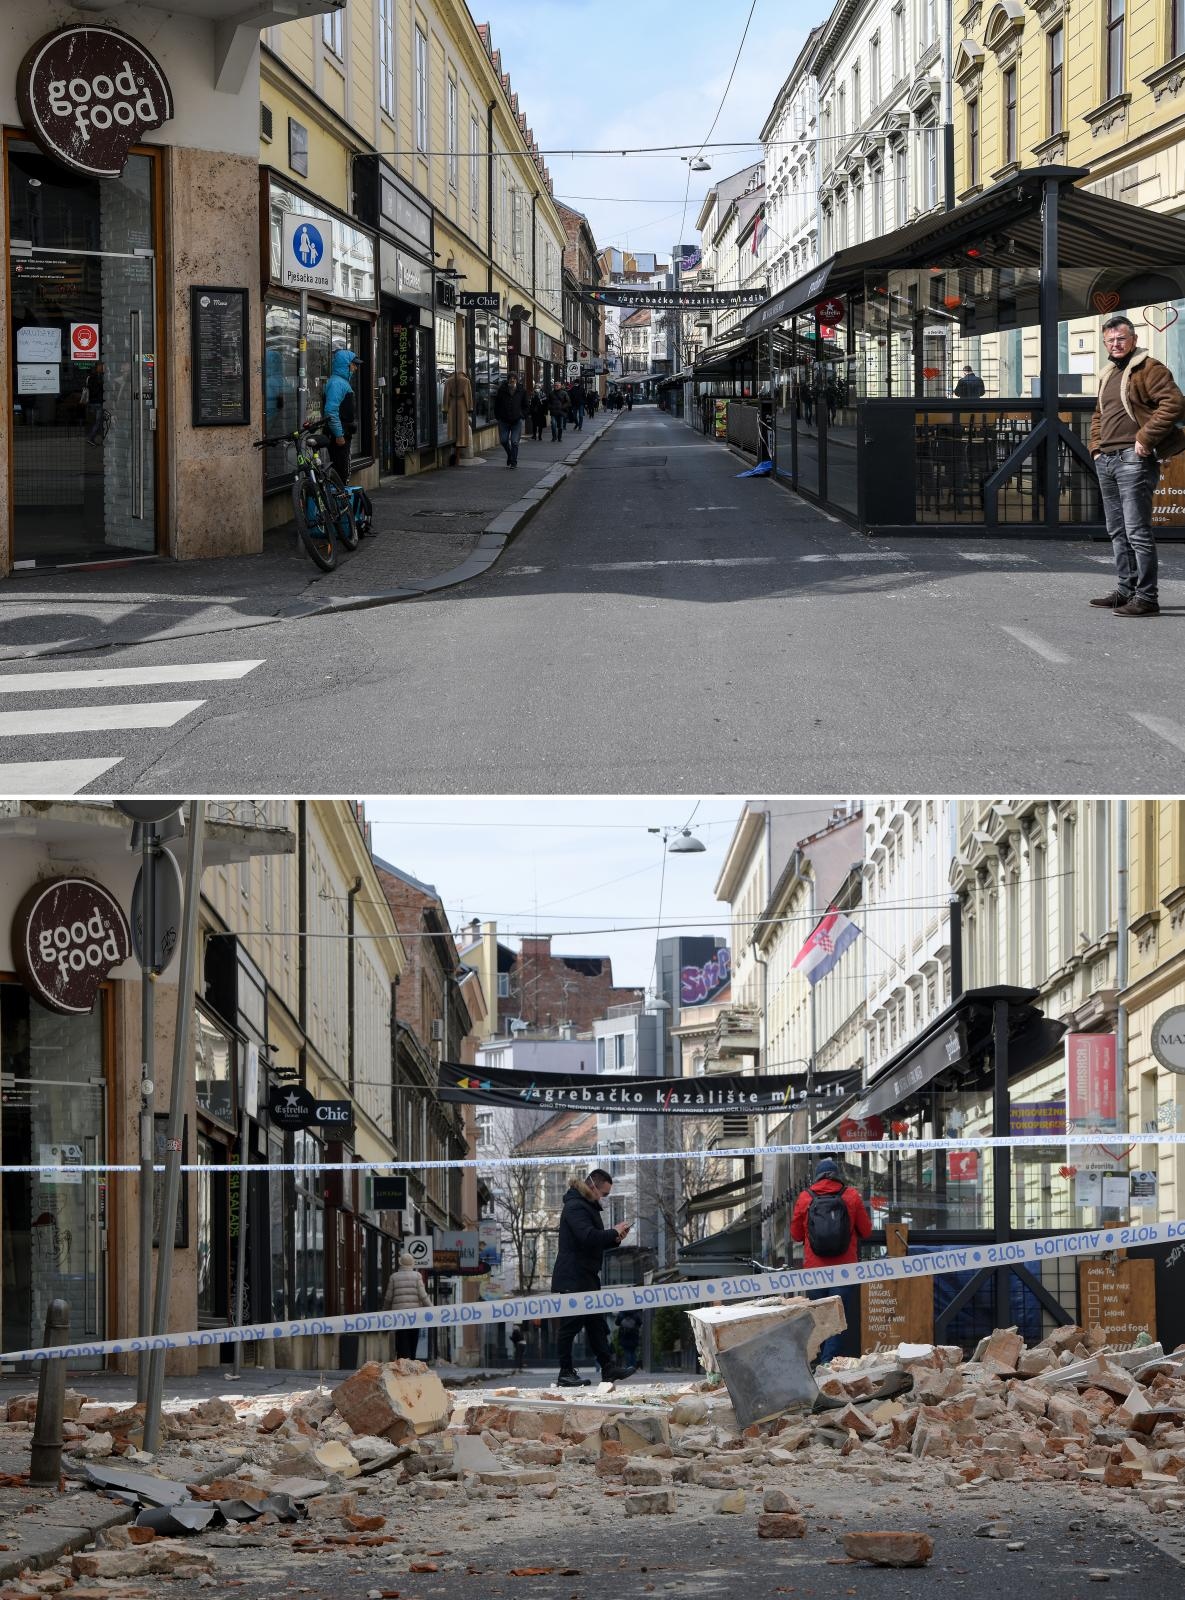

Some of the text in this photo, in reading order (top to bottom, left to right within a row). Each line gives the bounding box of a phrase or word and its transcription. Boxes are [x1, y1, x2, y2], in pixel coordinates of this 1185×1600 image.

[48, 61, 138, 117] good
[75, 87, 159, 141] food
[287, 271, 329, 286] Pješačka zona
[463, 296, 498, 306] Le Chic
[400, 327, 408, 386] FRESH SALADS
[38, 906, 106, 962] good
[58, 929, 120, 982] food
[274, 1104, 308, 1114] Estrella
[316, 1106, 349, 1120] Chic
[230, 1192, 240, 1238] SALADS
[1104, 1324, 1149, 1333] good food
